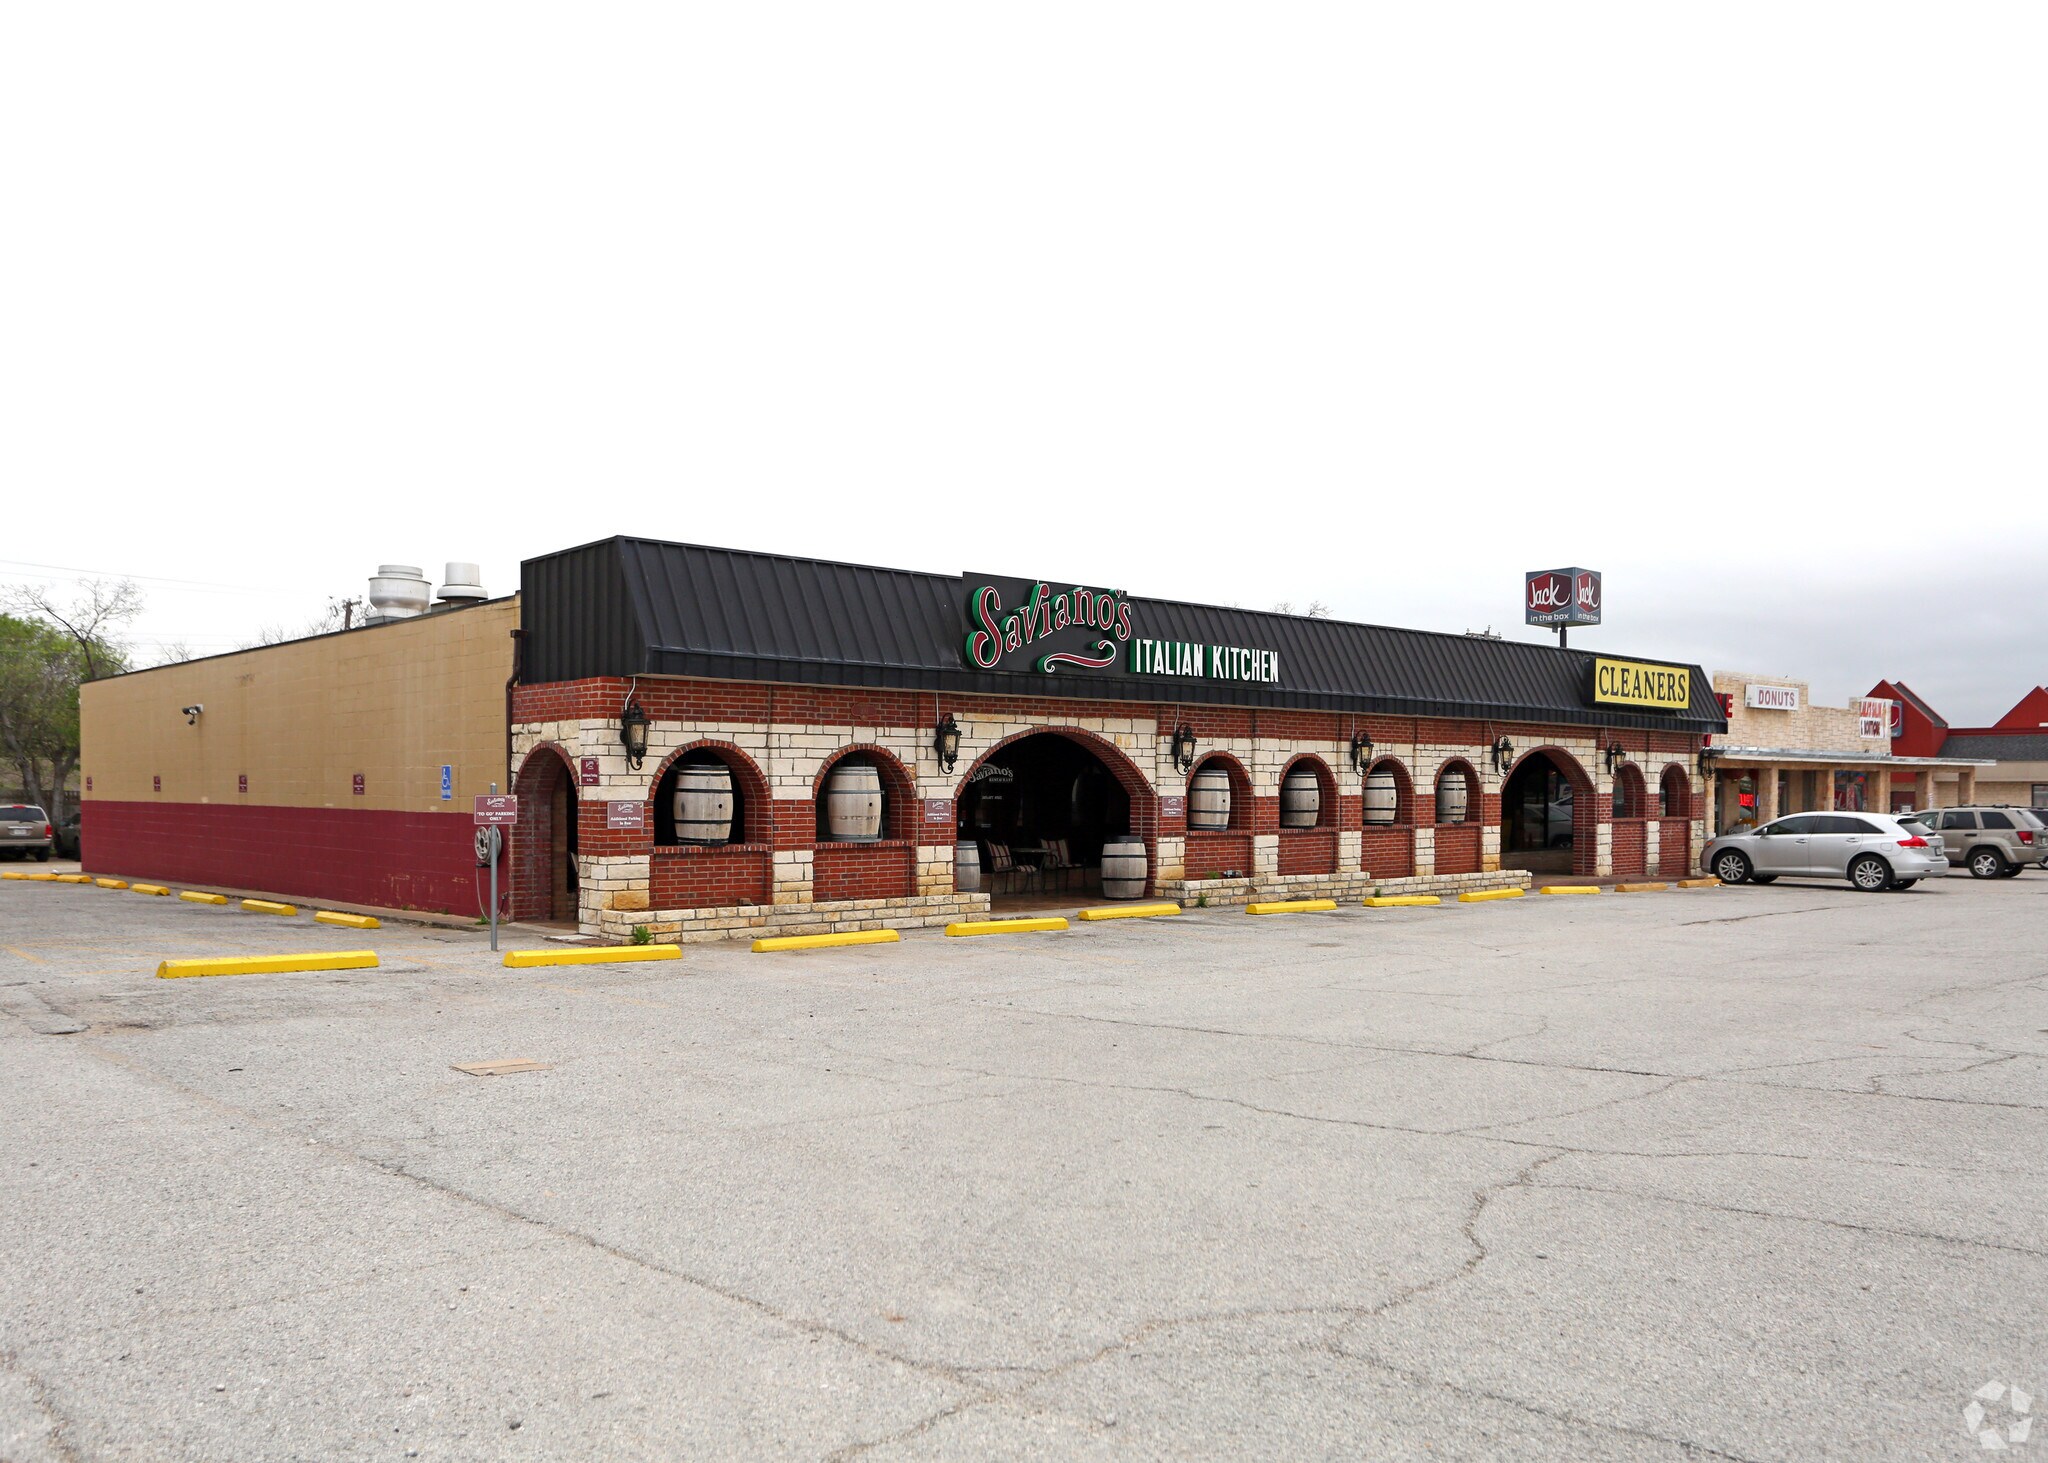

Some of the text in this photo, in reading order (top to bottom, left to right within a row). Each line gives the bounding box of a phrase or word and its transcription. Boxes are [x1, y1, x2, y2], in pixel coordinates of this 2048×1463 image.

[1529, 576, 1571, 608] Jack
[1576, 576, 1600, 608] Jack
[967, 580, 1132, 668] Saviano's
[1133, 638, 1279, 683] ITALIAN KITCHEN
[1598, 665, 1686, 703] CLEANERS
[1758, 689, 1795, 707] DONUTS
